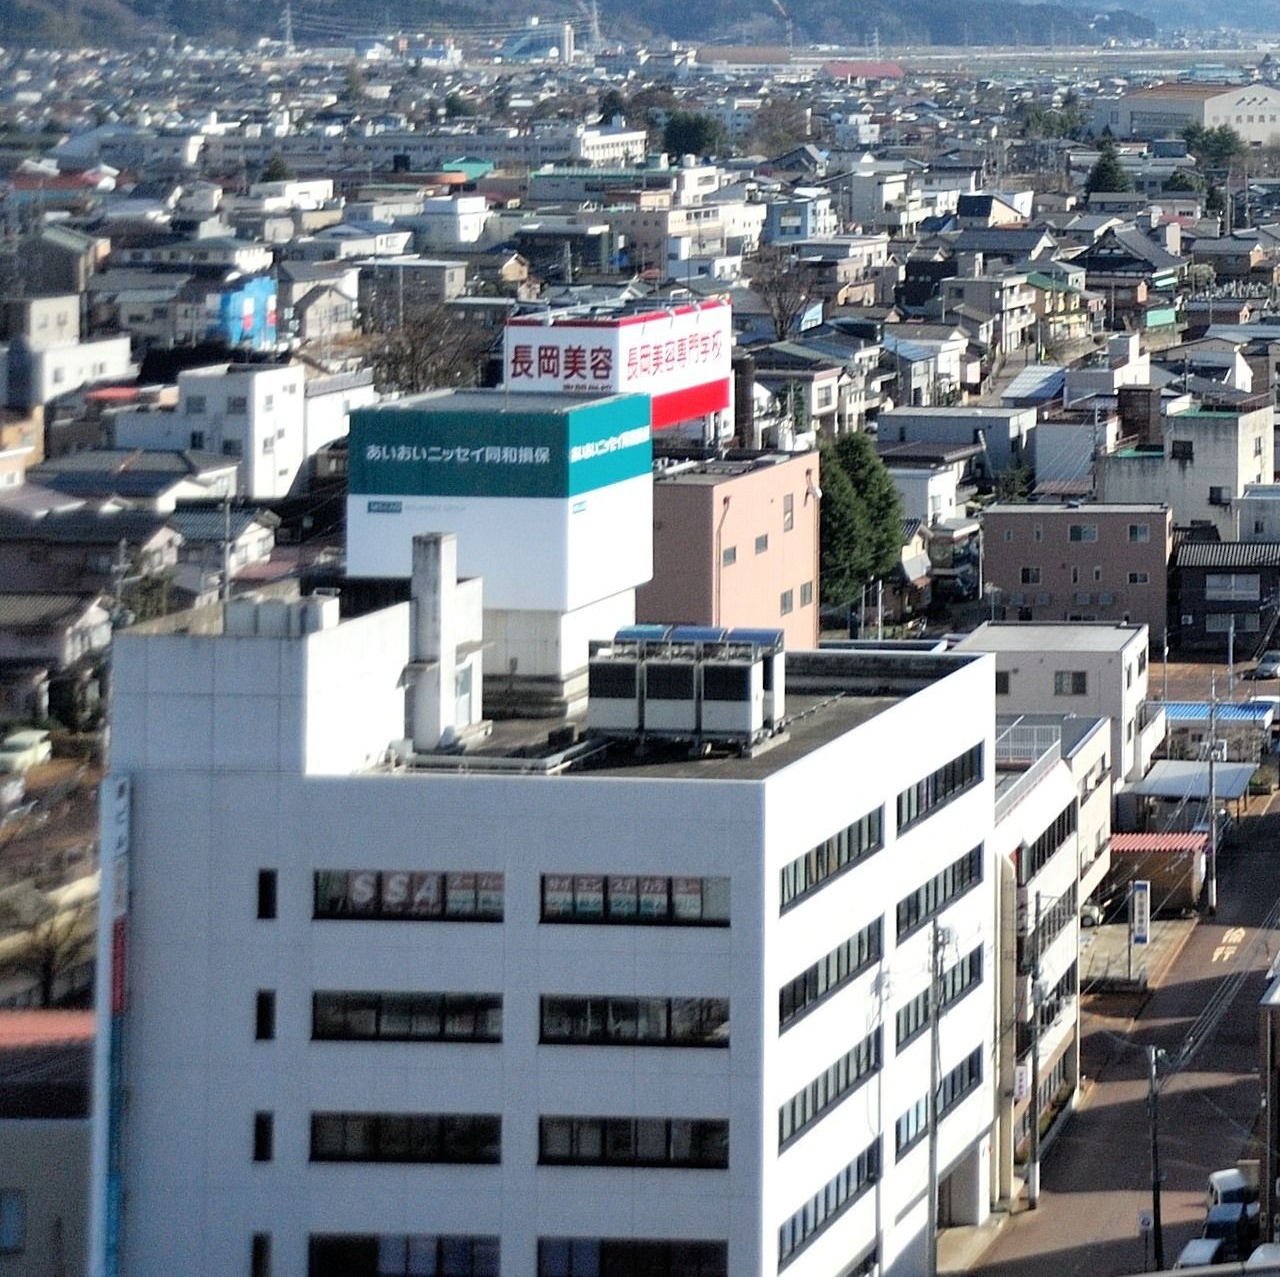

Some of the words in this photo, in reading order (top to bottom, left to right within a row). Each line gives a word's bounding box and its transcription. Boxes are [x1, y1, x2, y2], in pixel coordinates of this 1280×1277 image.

[511, 344, 613, 380] 長岡美容
[626, 330, 723, 381] 長岡美容専門学校
[366, 444, 550, 465] あいおいニッセイ同和損保
